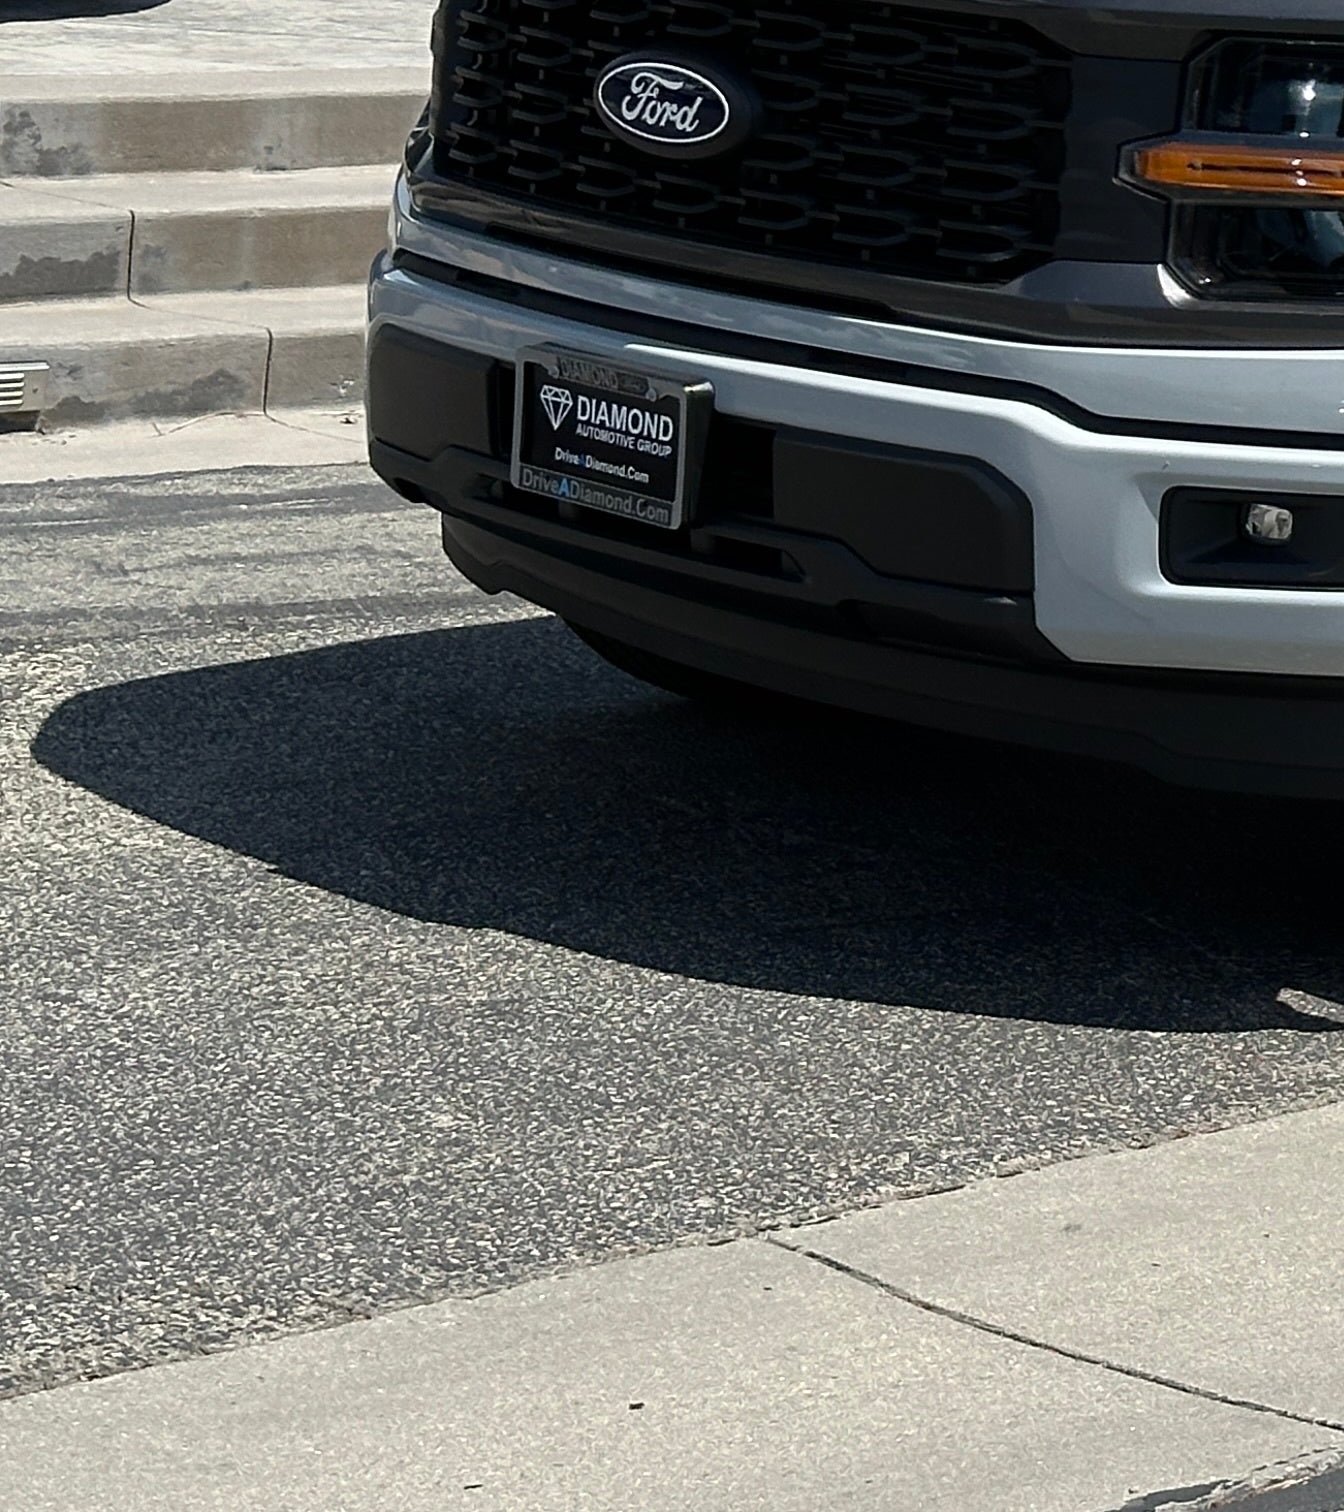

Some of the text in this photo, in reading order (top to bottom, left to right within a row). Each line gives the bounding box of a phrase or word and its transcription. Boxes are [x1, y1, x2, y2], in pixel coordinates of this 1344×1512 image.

[621, 71, 703, 132] Ford
[577, 394, 674, 442] DIAMOND
[577, 423, 672, 457] AUTOMOTIVE GROUP
[522, 468, 669, 523] DriveADiamond.Com
